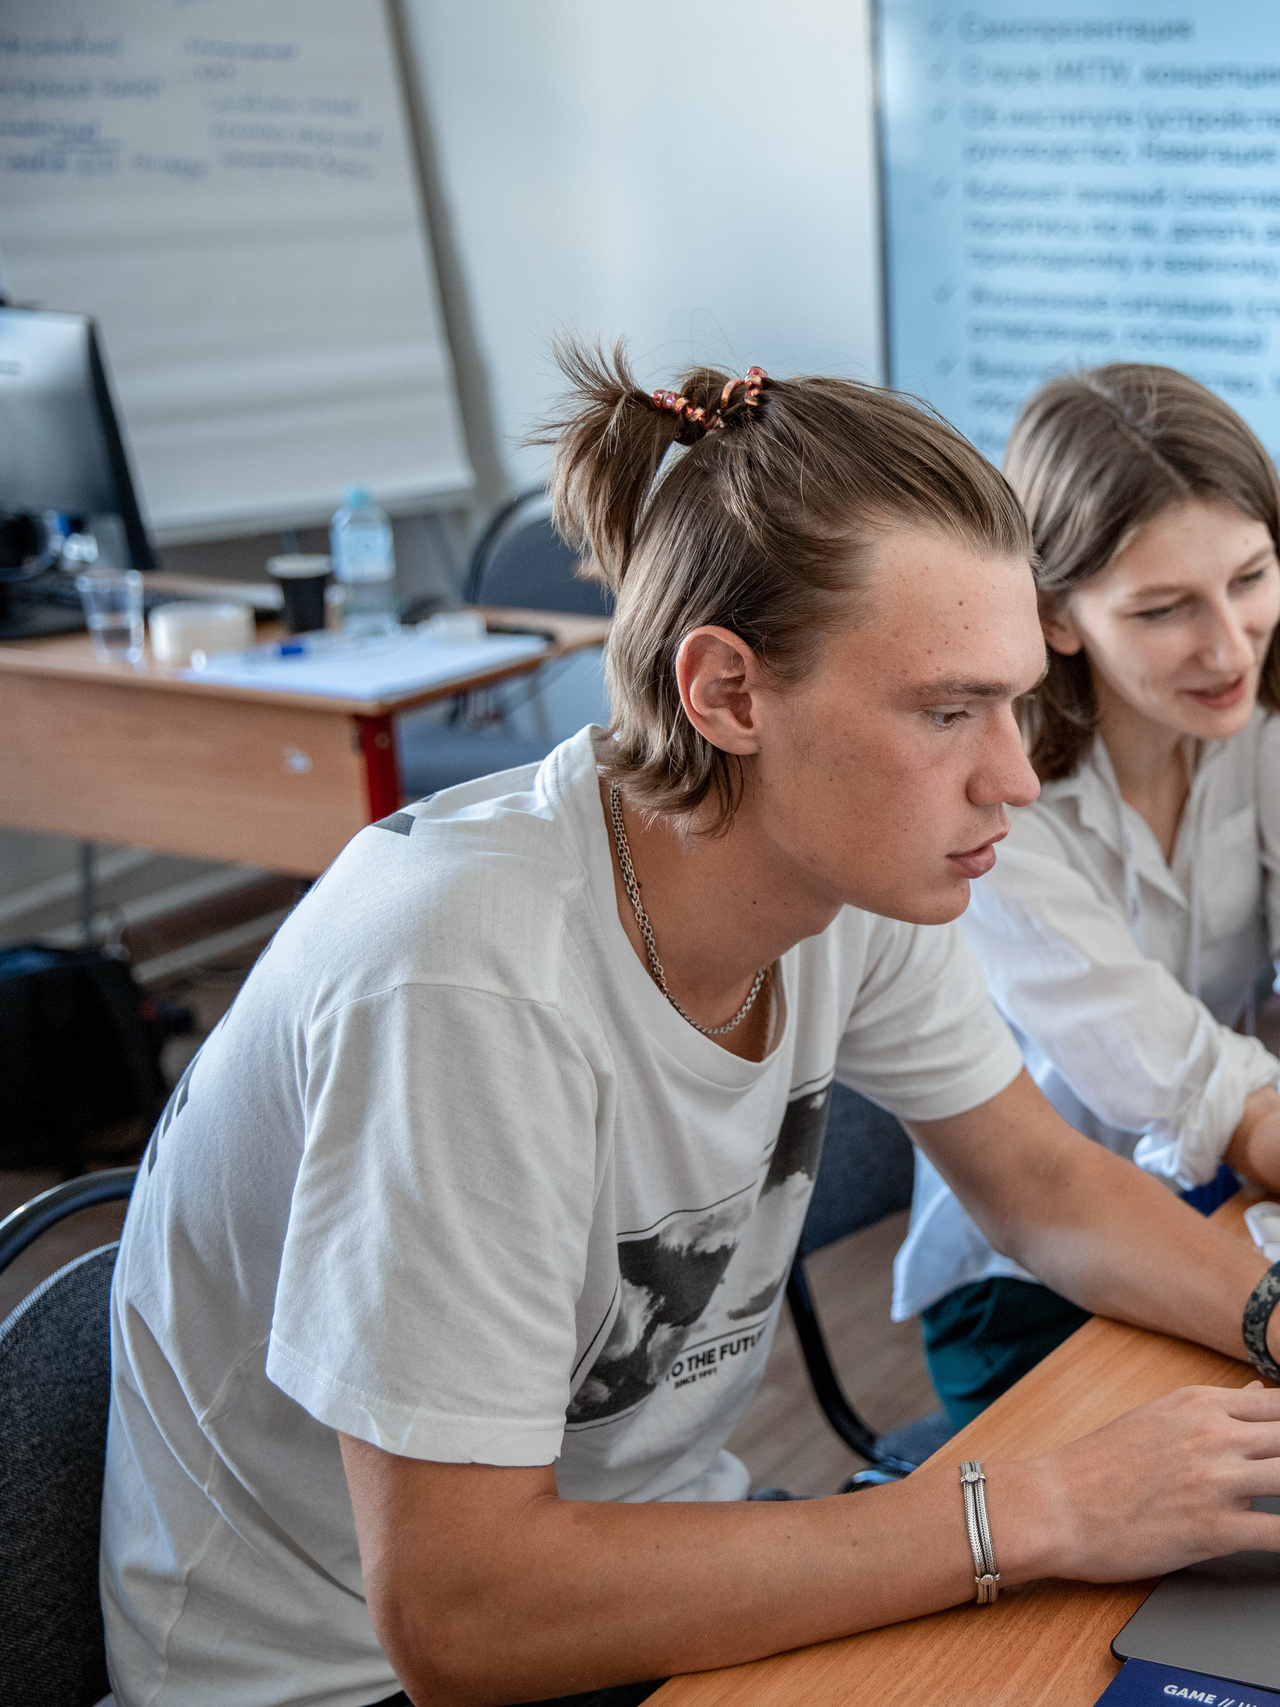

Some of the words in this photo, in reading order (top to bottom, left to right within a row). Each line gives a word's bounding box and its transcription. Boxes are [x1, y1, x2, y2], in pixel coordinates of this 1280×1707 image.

[687, 1348, 716, 1372] THE
[674, 1374, 697, 1390] SINCE
[1163, 1684, 1217, 1704] GAME
